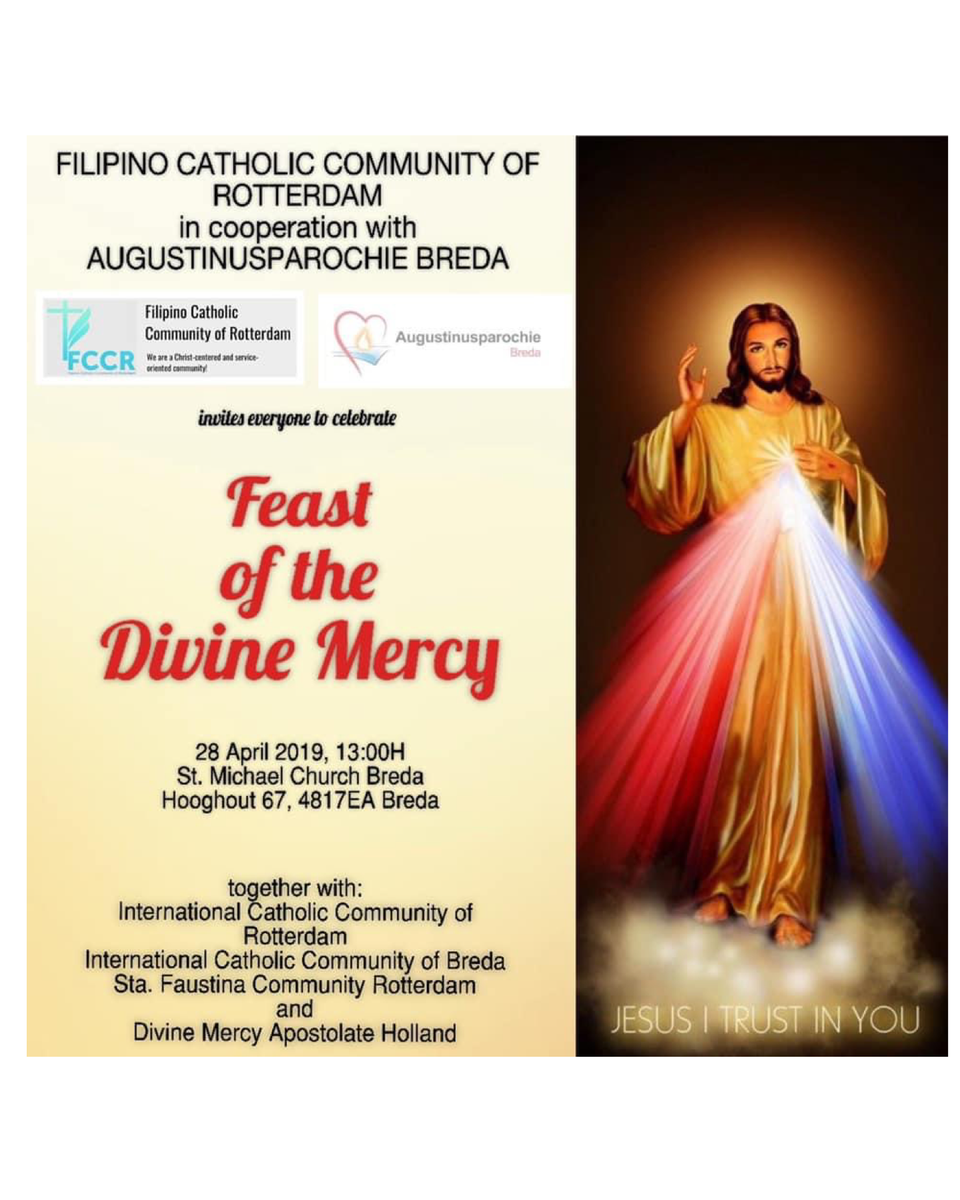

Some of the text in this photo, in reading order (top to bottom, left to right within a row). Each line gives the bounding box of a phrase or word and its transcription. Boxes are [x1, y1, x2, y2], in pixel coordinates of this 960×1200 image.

[56, 151, 540, 176] FILIPINO CATHOLIC COMMUNITY OF
[213, 183, 382, 207] ROTTERDAM
[179, 215, 417, 243] in cooperation with
[87, 246, 510, 271] AUGUSTINUSPAROCHIE BREDA
[145, 304, 239, 321] Filipino Catholic
[145, 326, 291, 343] Community of Rotterdam
[395, 330, 541, 346] Augustinusparochie
[67, 350, 136, 371] FCCR
[146, 353, 157, 362] We
[174, 353, 221, 362] Christ-centered
[222, 354, 234, 362] and
[234, 354, 259, 362] service-
[509, 348, 541, 358] Breda
[146, 364, 208, 374] oriented community!
[197, 408, 398, 432] invites everyone to celebrate
[225, 474, 374, 529] Feast
[218, 544, 380, 619] of the
[99, 619, 500, 701] Divine Mercy
[195, 742, 405, 766] 28 April 2019, 13:00H
[176, 765, 425, 786] St. Michael Church Breda
[162, 790, 440, 814] Hooghout 67, 4817EA Breda
[227, 878, 362, 901] together with:
[119, 902, 474, 926] International Catholic Community of
[243, 926, 348, 946] Rotterdam
[85, 949, 506, 973] International Catholic Community of Breda
[114, 974, 476, 998] Sta. Faustina Community Rotterdam
[276, 998, 314, 1019] and
[610, 1005, 920, 1034] JESUS I TRUST IN YOU
[134, 1022, 457, 1047] Divine Mercy Apostolate Holland
